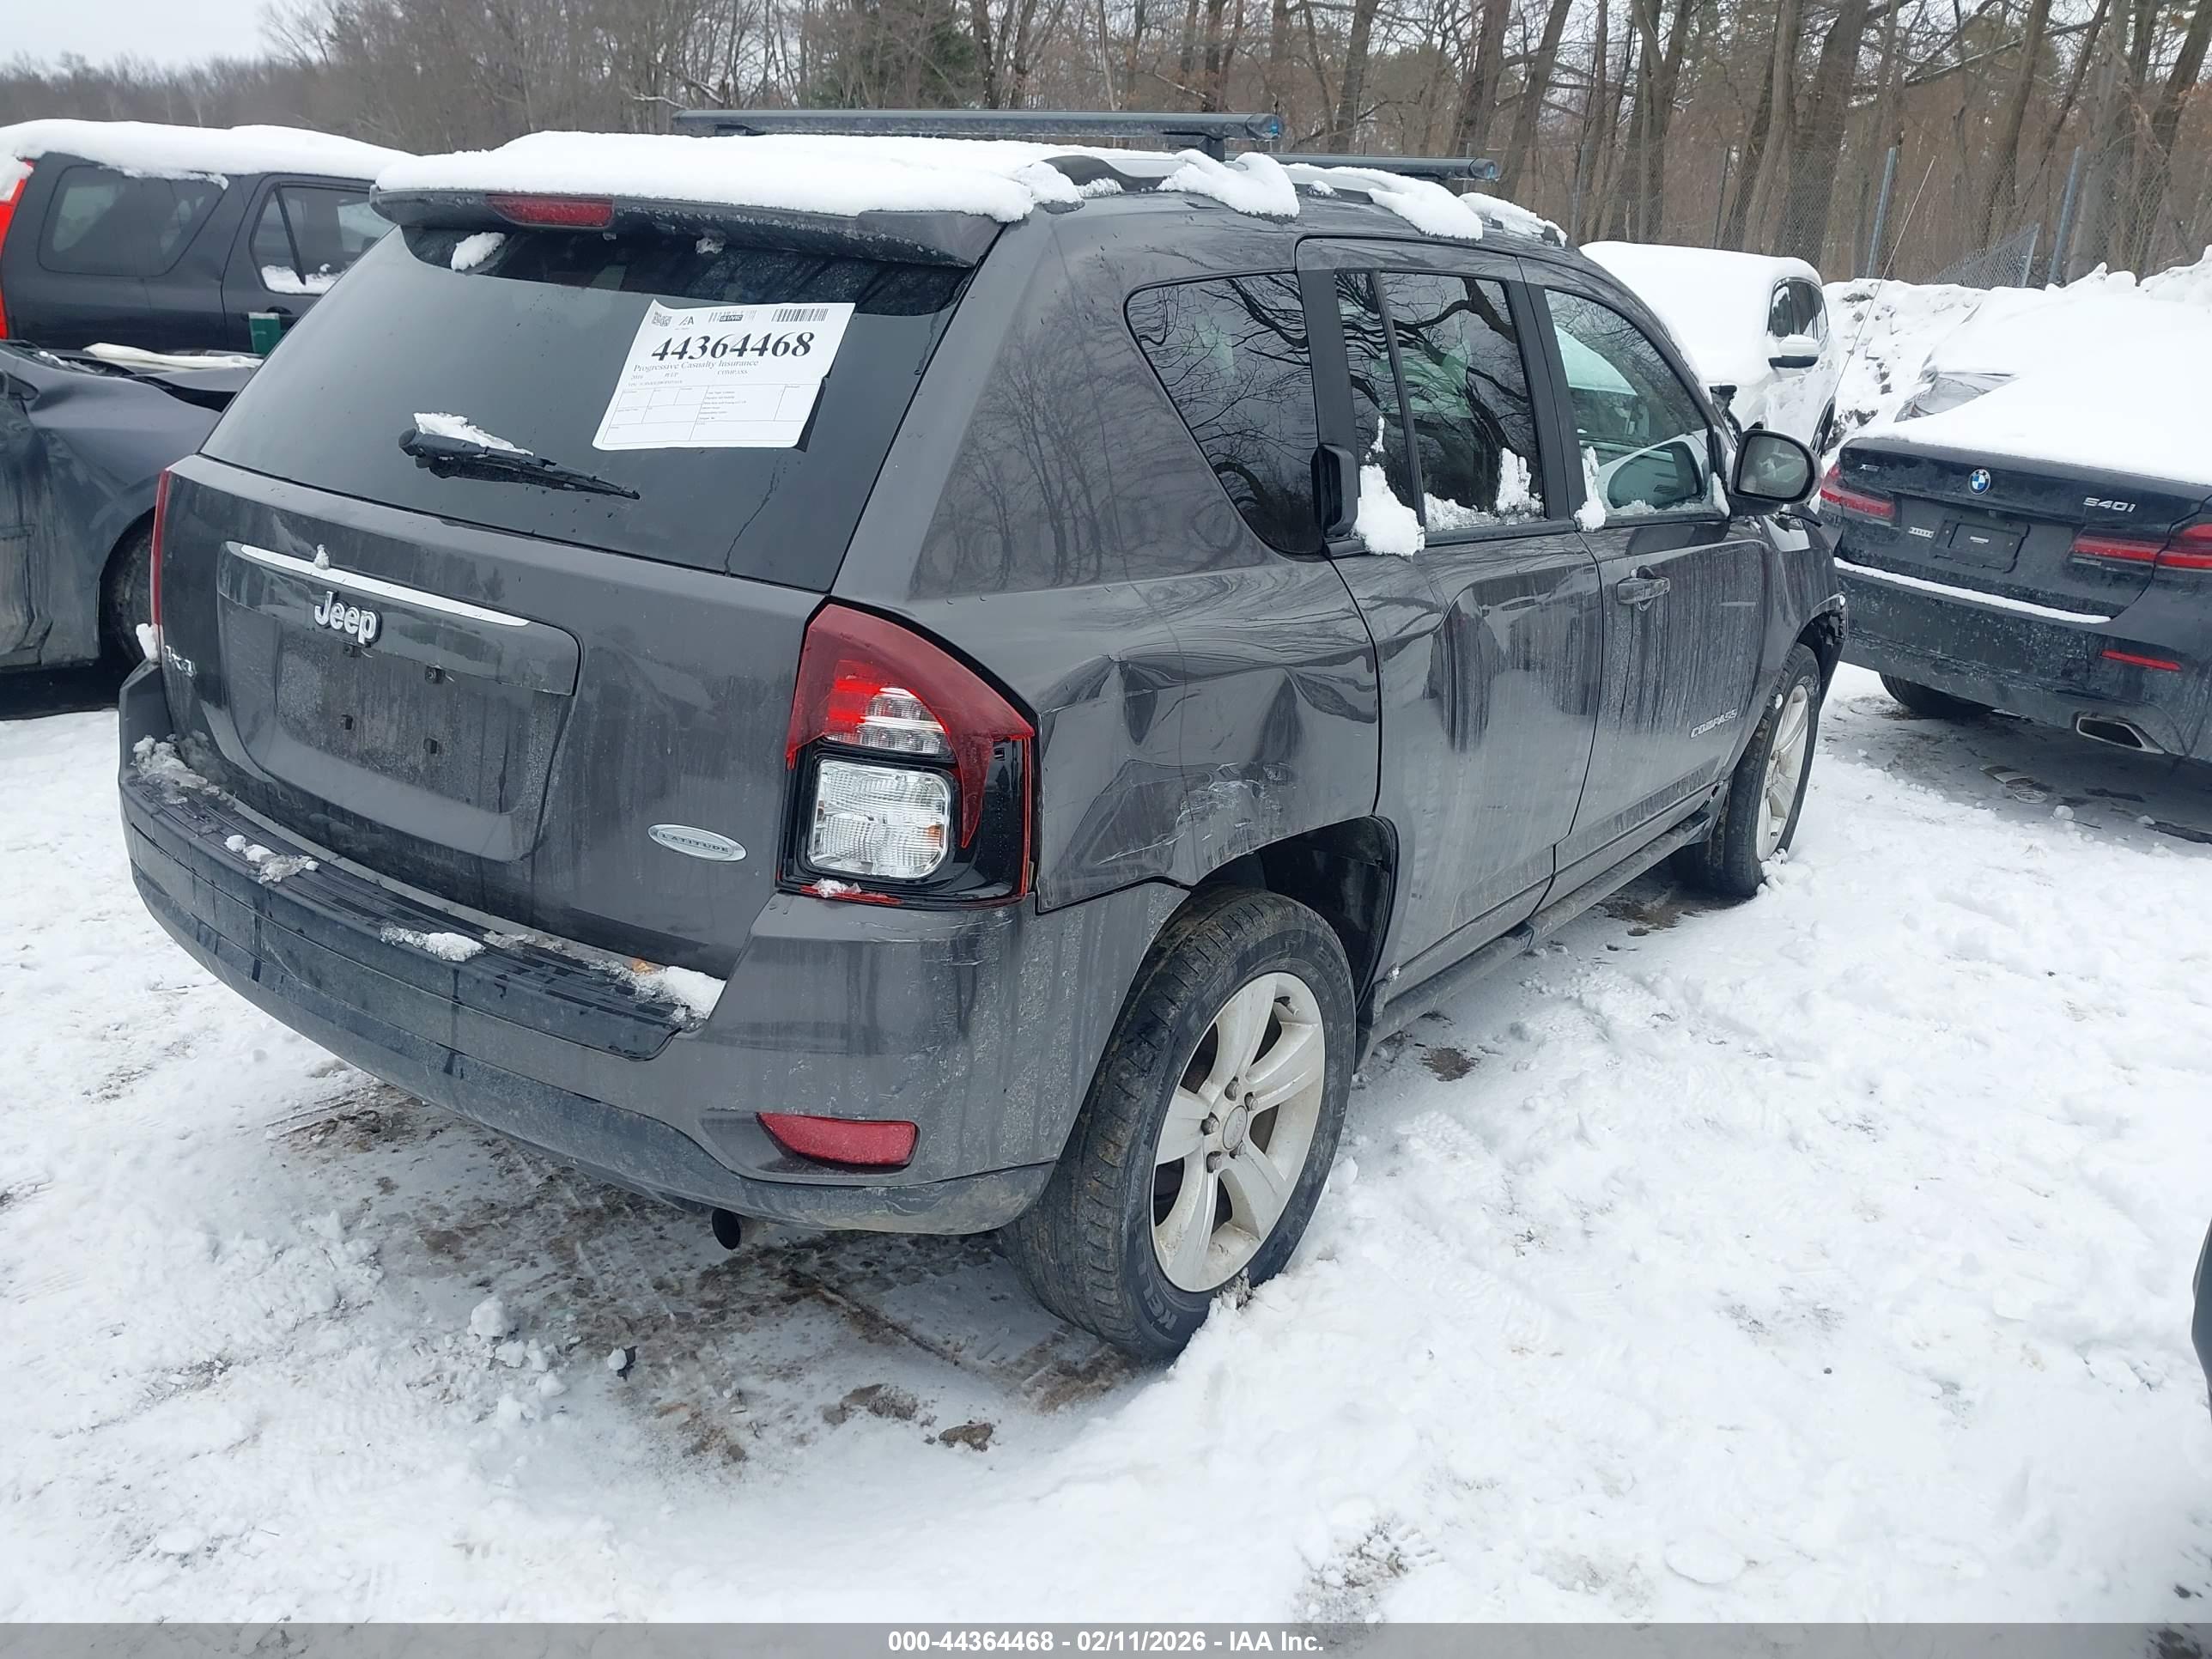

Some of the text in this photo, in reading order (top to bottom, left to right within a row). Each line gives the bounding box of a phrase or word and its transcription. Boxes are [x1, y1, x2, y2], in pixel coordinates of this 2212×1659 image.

[651, 331, 815, 361] 44364468
[633, 359, 759, 373] Progressive Casualty Insurance
[314, 590, 378, 645] Jeep
[1690, 708, 1738, 738] COMPASS
[660, 832, 730, 854] LATITUDE
